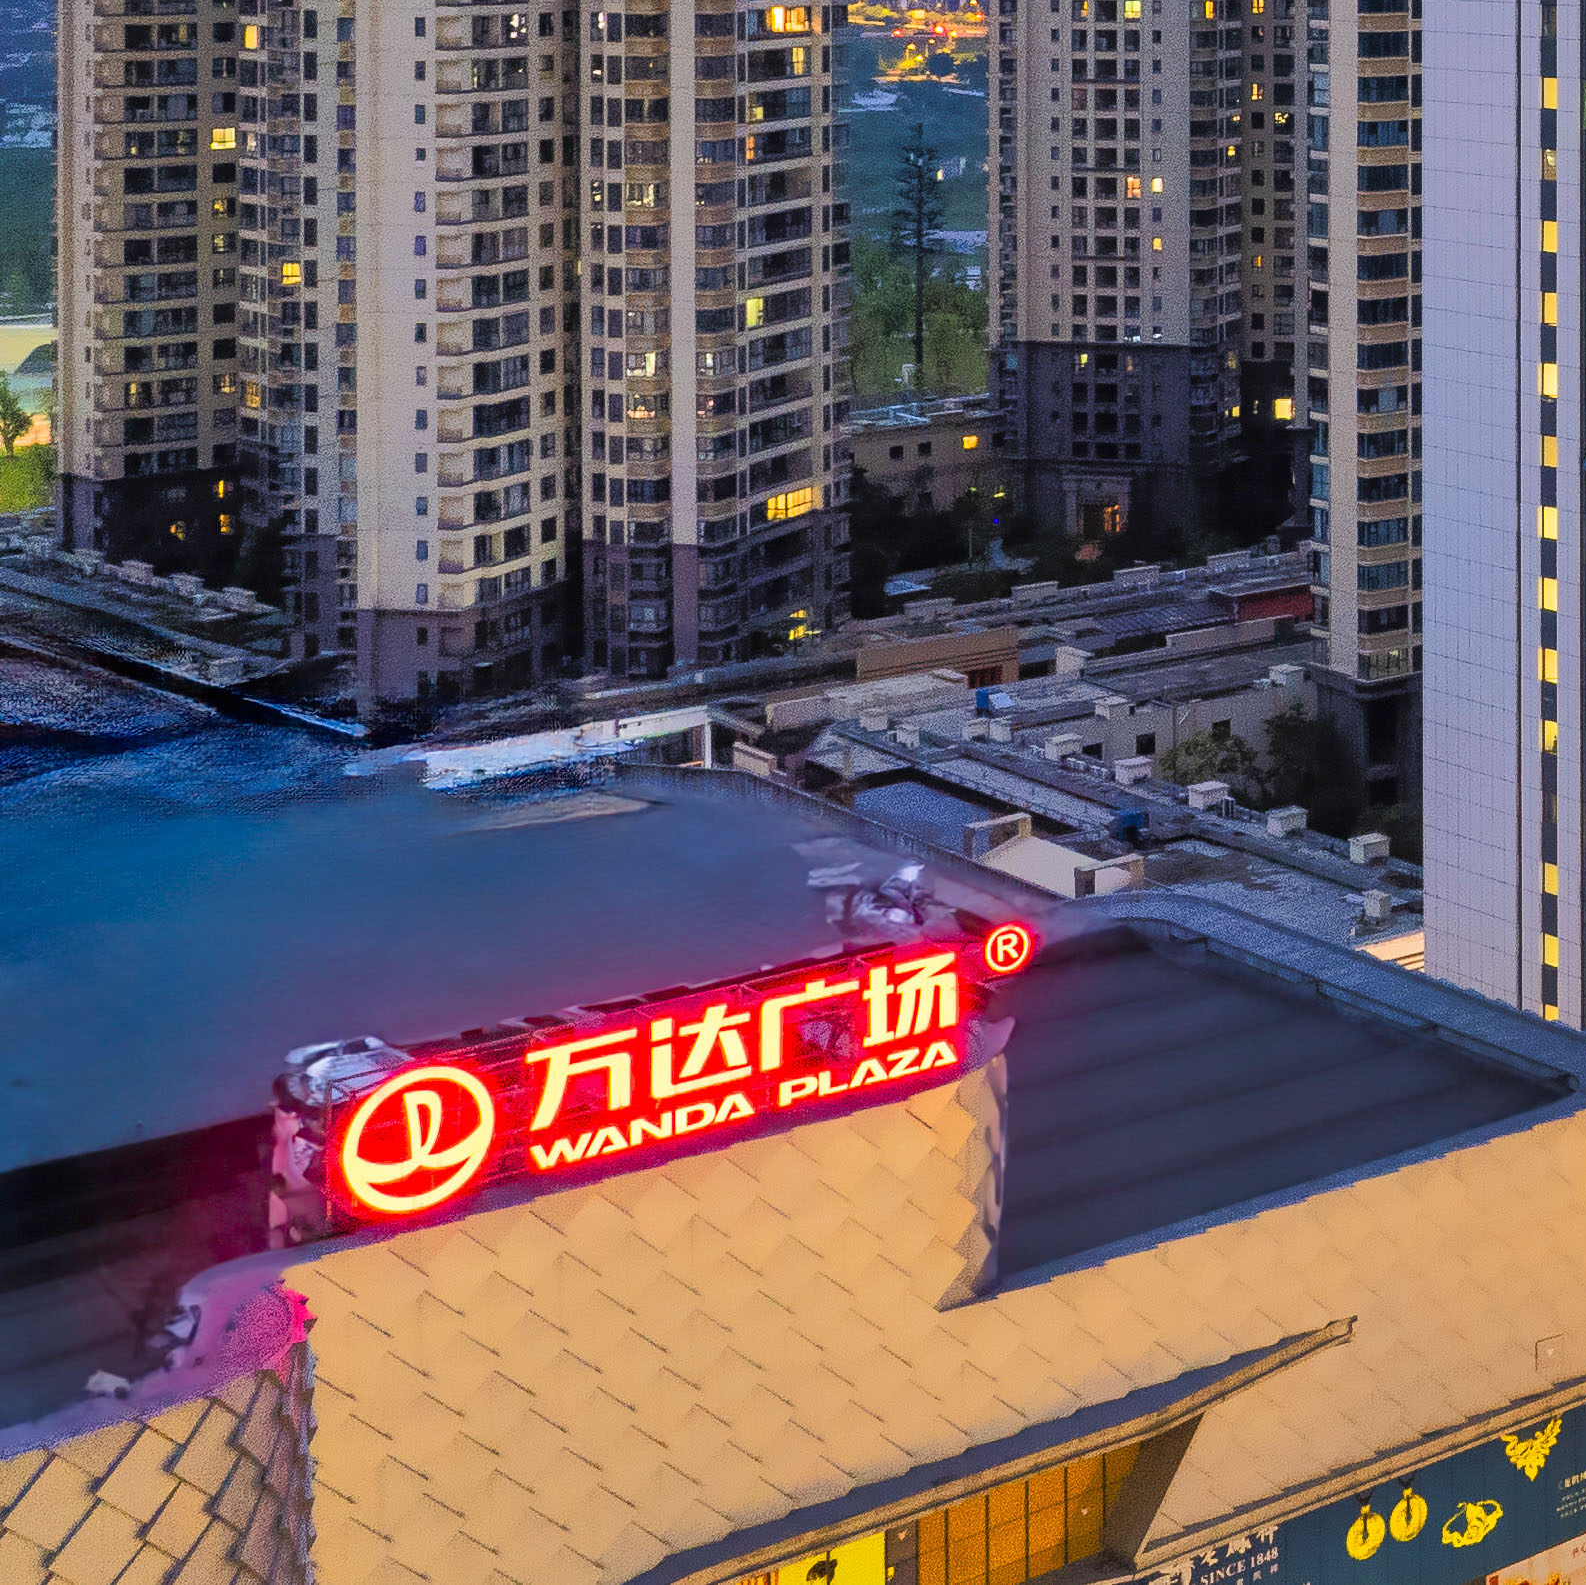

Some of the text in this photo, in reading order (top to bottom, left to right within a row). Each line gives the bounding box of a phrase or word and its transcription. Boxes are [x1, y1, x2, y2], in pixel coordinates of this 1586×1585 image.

[525, 951, 957, 1132] 万达广场
[529, 1041, 958, 1170] WANDA PLAZA
[1200, 1558, 1246, 1585] SINCE
[1250, 1546, 1279, 1568] 1848
